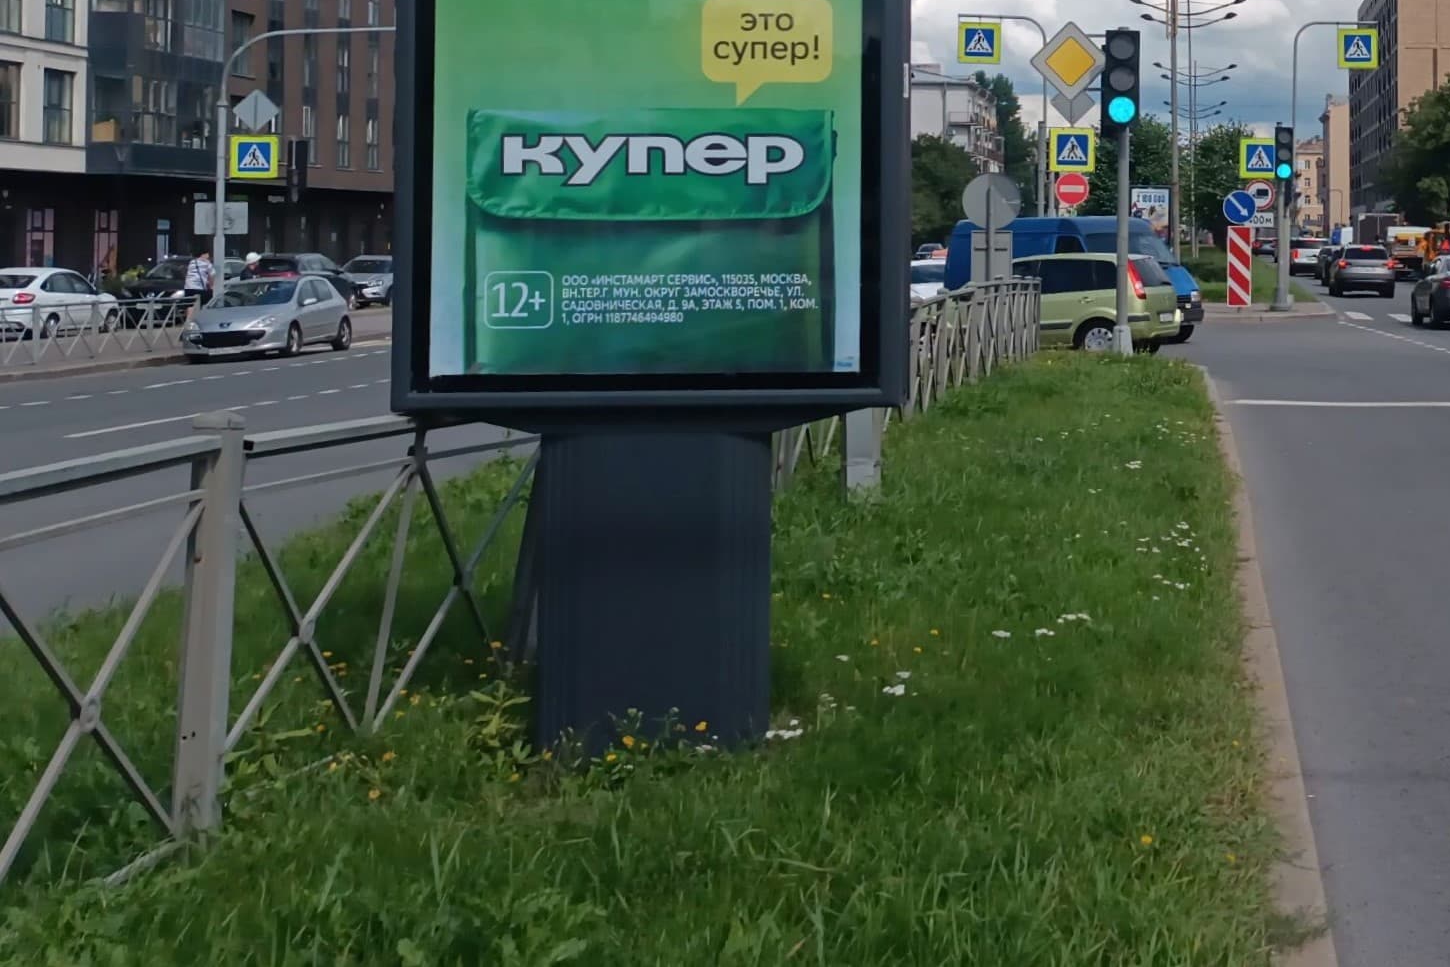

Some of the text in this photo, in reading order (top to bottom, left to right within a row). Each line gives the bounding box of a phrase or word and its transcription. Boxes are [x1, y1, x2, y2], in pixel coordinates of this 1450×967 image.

[740, 12, 795, 32] это
[713, 35, 820, 64] супер!
[501, 133, 804, 187] купер
[562, 275, 589, 286] ООО
[591, 274, 664, 286] «ИНСТАМАРТ
[721, 274, 758, 286] 115035,
[761, 274, 812, 286] МОСКВА,
[490, 282, 546, 318] 12+
[644, 287, 681, 298] ОКРУГ
[684, 286, 784, 298] ЗАМОСКВОРЕЧЬЕ,
[787, 286, 805, 297] УЛ.
[562, 300, 664, 311] САДОВНИЧЕСКАЯ,
[702, 299, 733, 310] ЭТАЖ
[748, 299, 777, 310] ПОМ.
[790, 298, 818, 309] КОМ.
[572, 313, 603, 323] ОГРН
